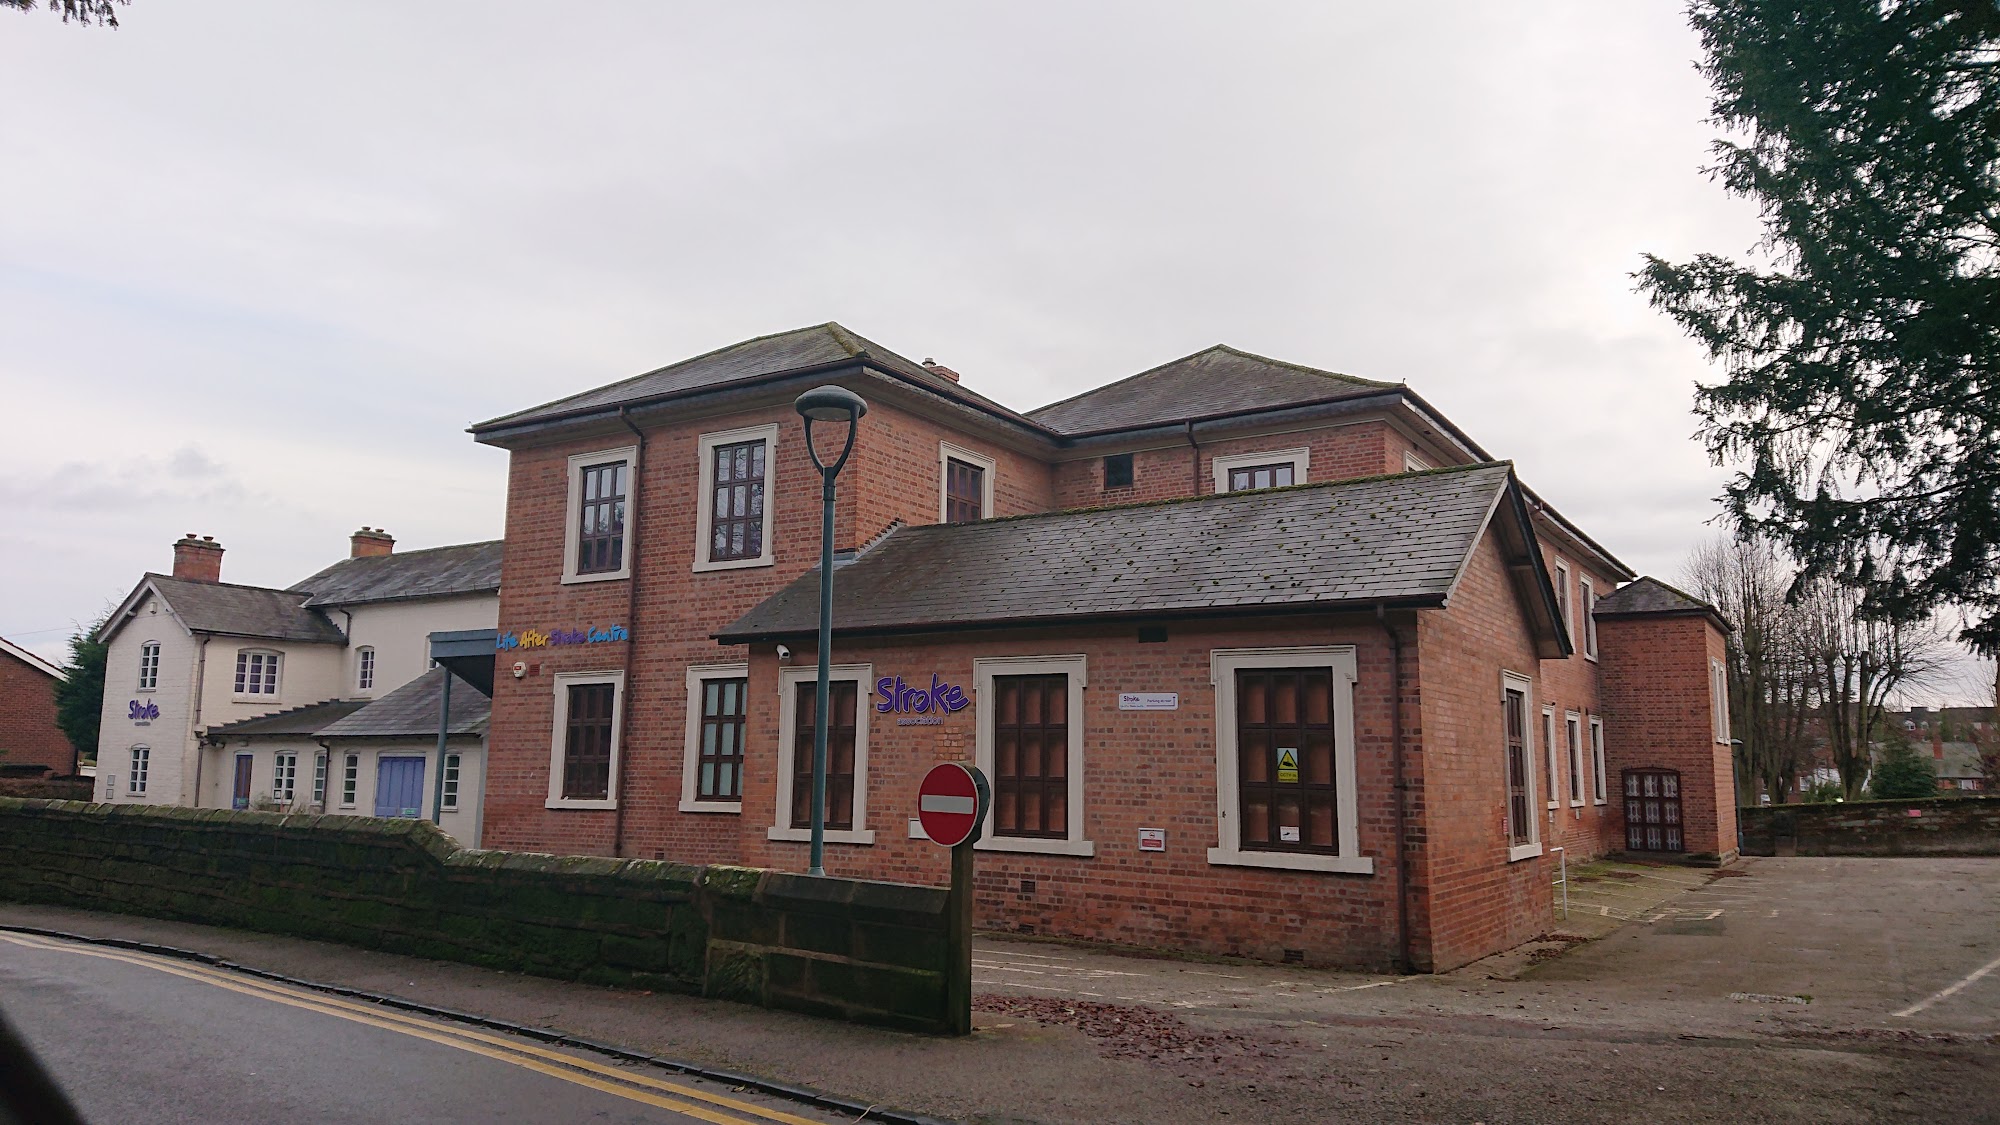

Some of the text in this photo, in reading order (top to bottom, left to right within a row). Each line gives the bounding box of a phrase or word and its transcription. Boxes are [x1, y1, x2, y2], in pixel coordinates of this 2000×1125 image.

[496, 623, 628, 652] Life After Stroke Centre
[876, 672, 970, 716] Stroke
[127, 697, 160, 721] Stroke
[896, 716, 944, 726] association
